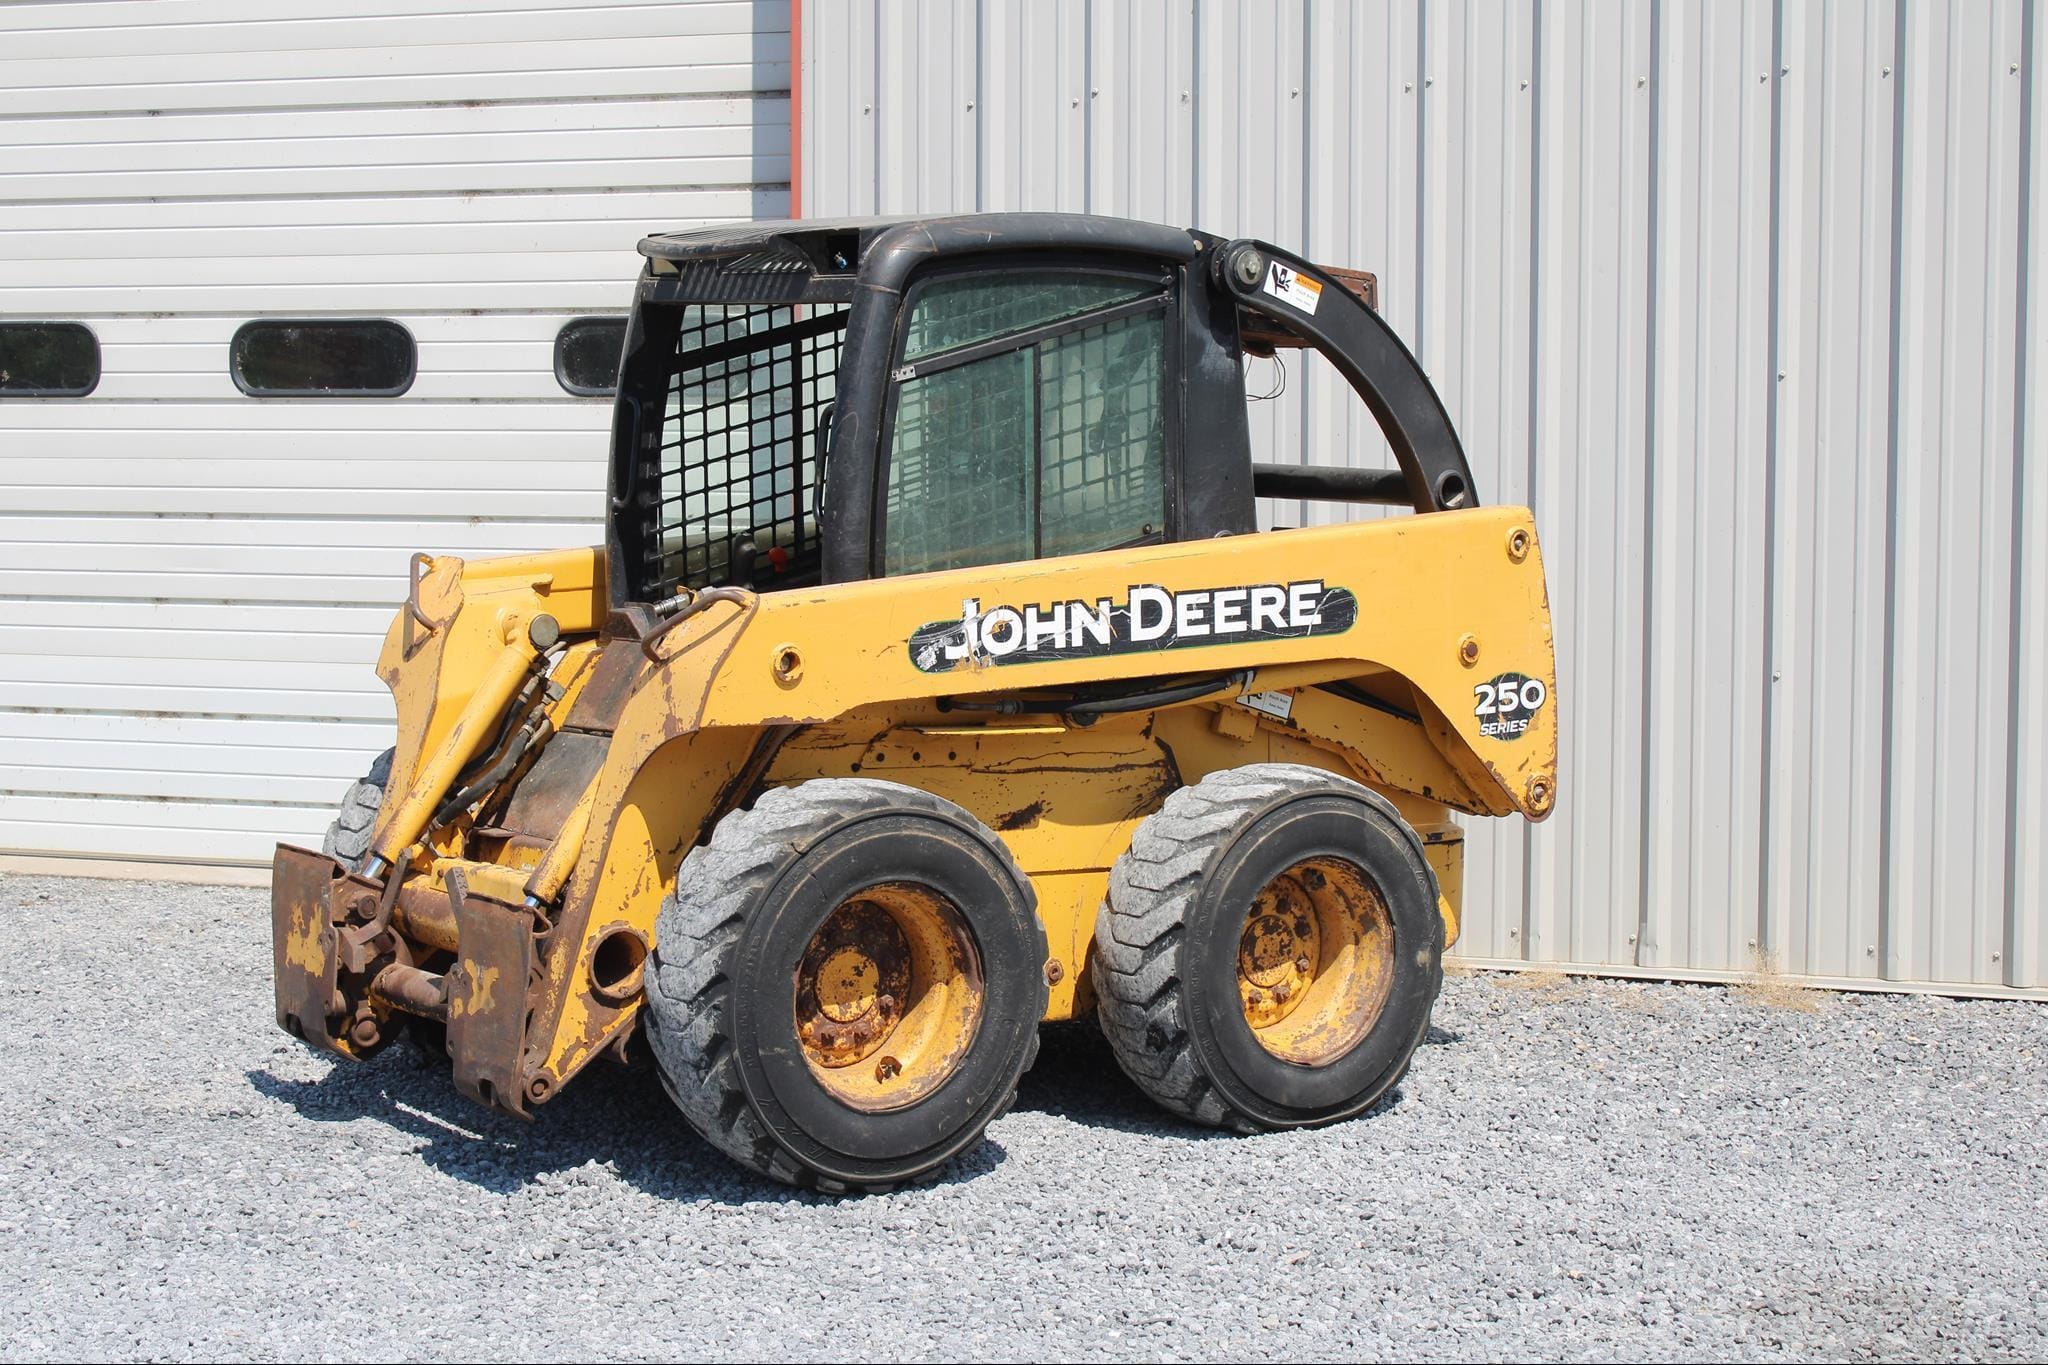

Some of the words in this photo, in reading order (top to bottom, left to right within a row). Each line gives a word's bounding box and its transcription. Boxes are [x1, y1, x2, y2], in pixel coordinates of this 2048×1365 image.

[945, 599, 1112, 660] JOHN
[1130, 583, 1323, 642] DEERE
[1474, 680, 1546, 715] 250
[1480, 719, 1529, 736] SERIES
